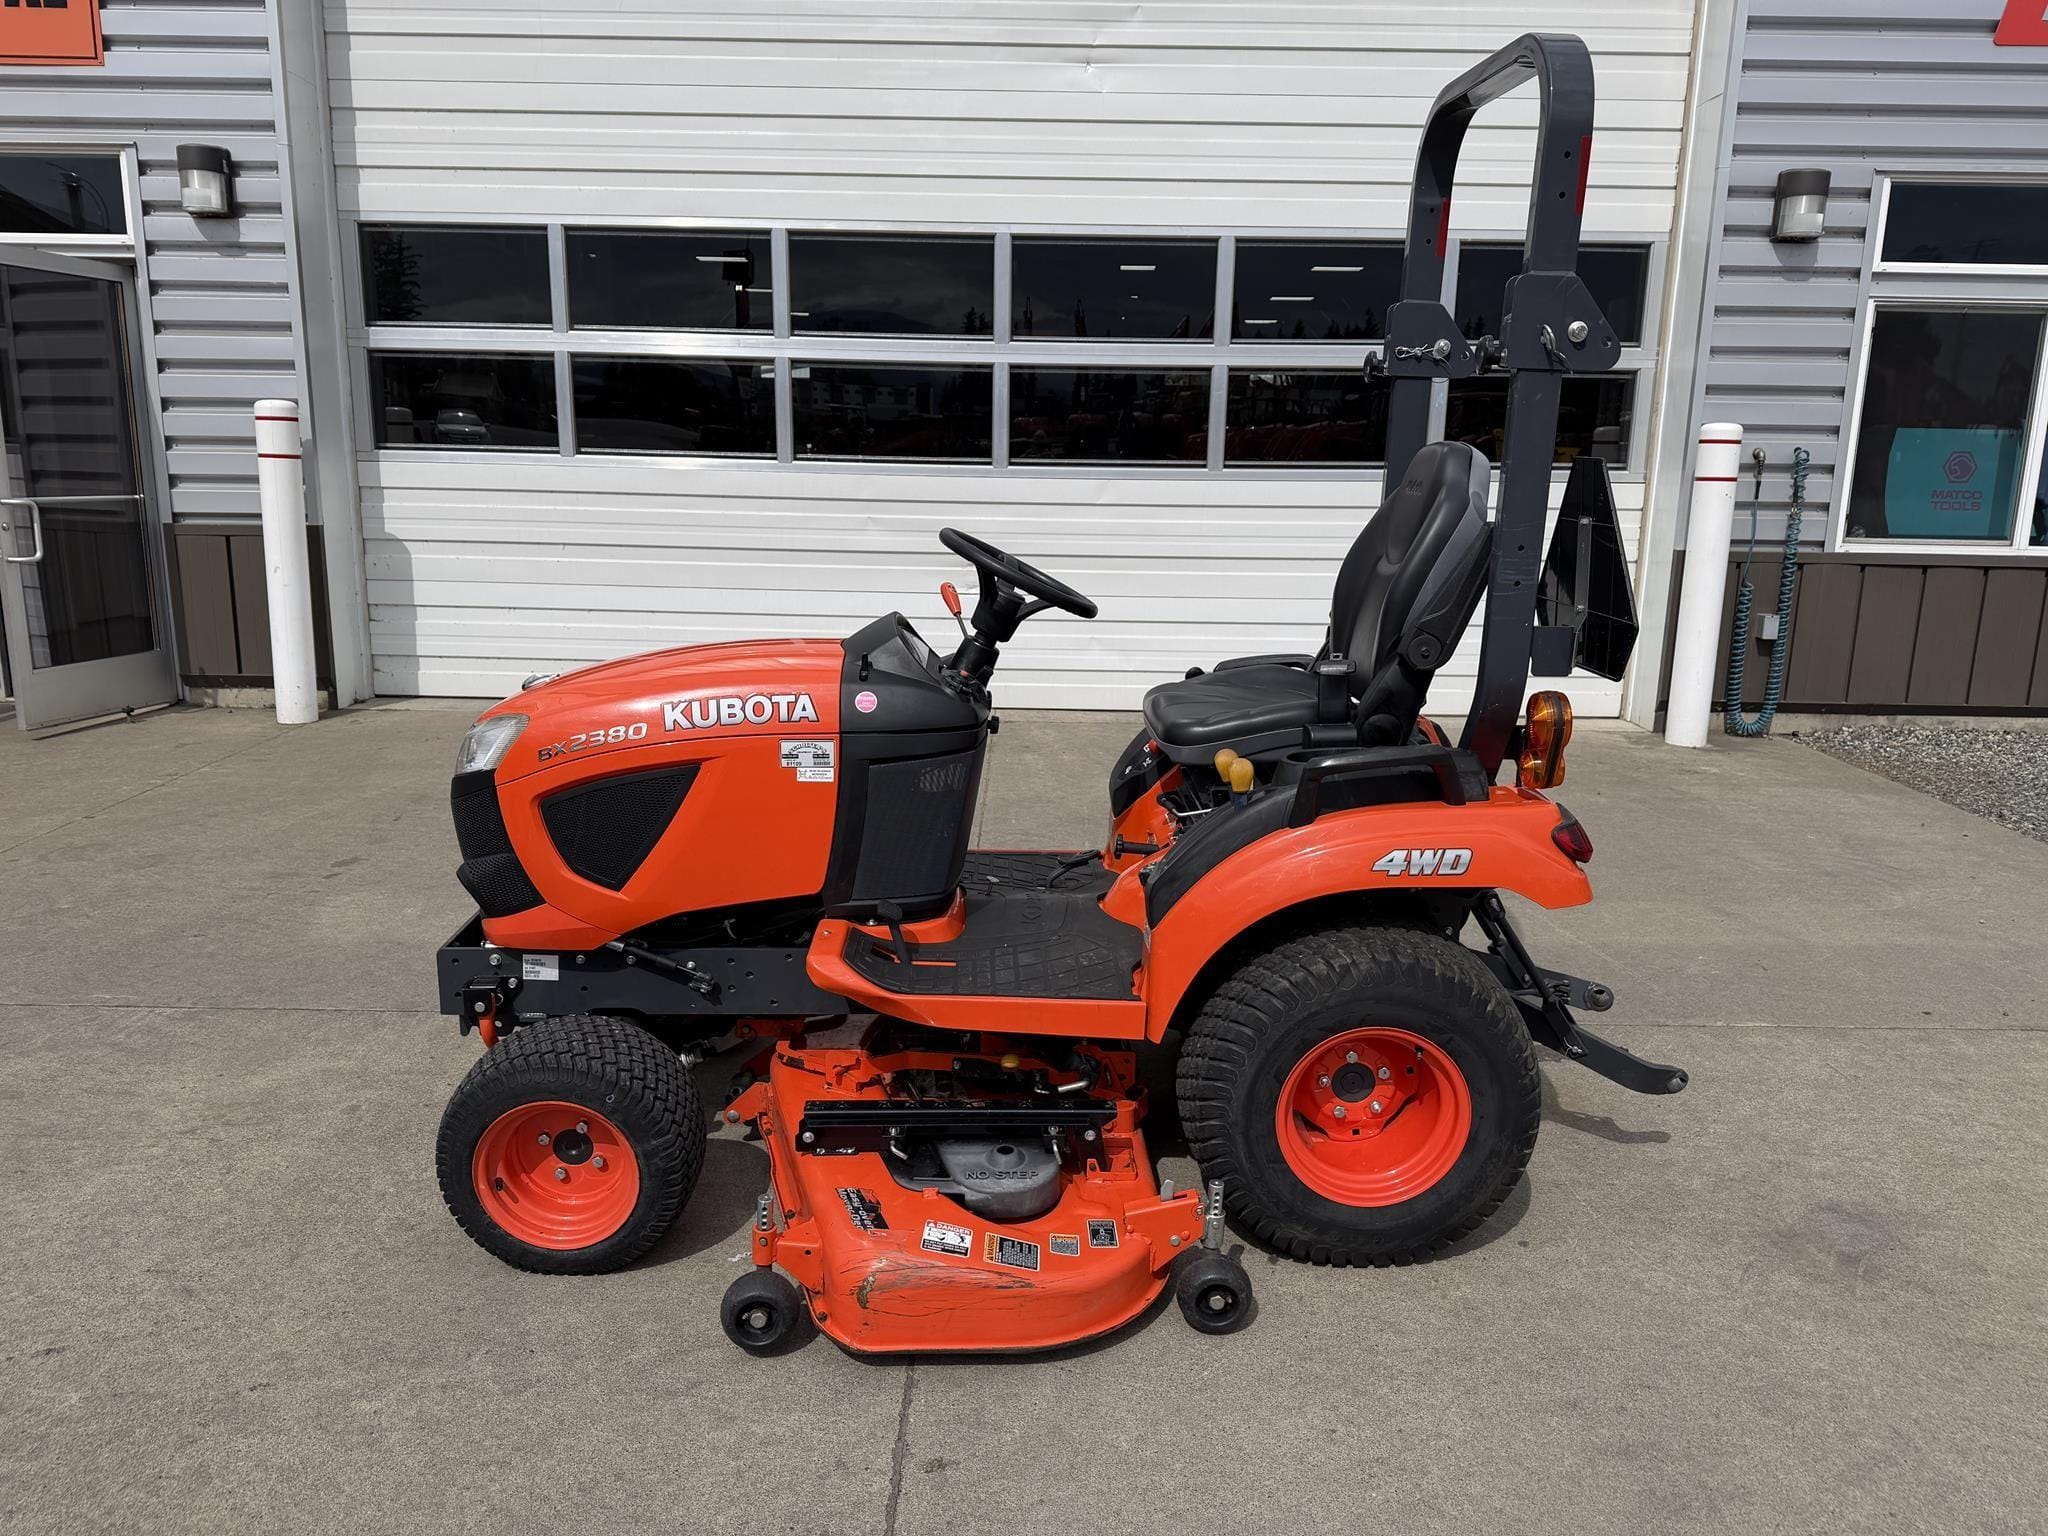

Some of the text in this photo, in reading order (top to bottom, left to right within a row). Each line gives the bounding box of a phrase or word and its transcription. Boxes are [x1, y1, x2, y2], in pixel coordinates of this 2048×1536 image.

[1931, 489, 1983, 500] MATCO
[1930, 500, 1982, 511] TOOLS
[663, 693, 819, 732] KUBOTA
[538, 722, 648, 762] BX2380
[1371, 848, 1473, 877] 4WD
[965, 1170, 1039, 1180] NO STEP
[936, 1223, 971, 1236] DANGER
